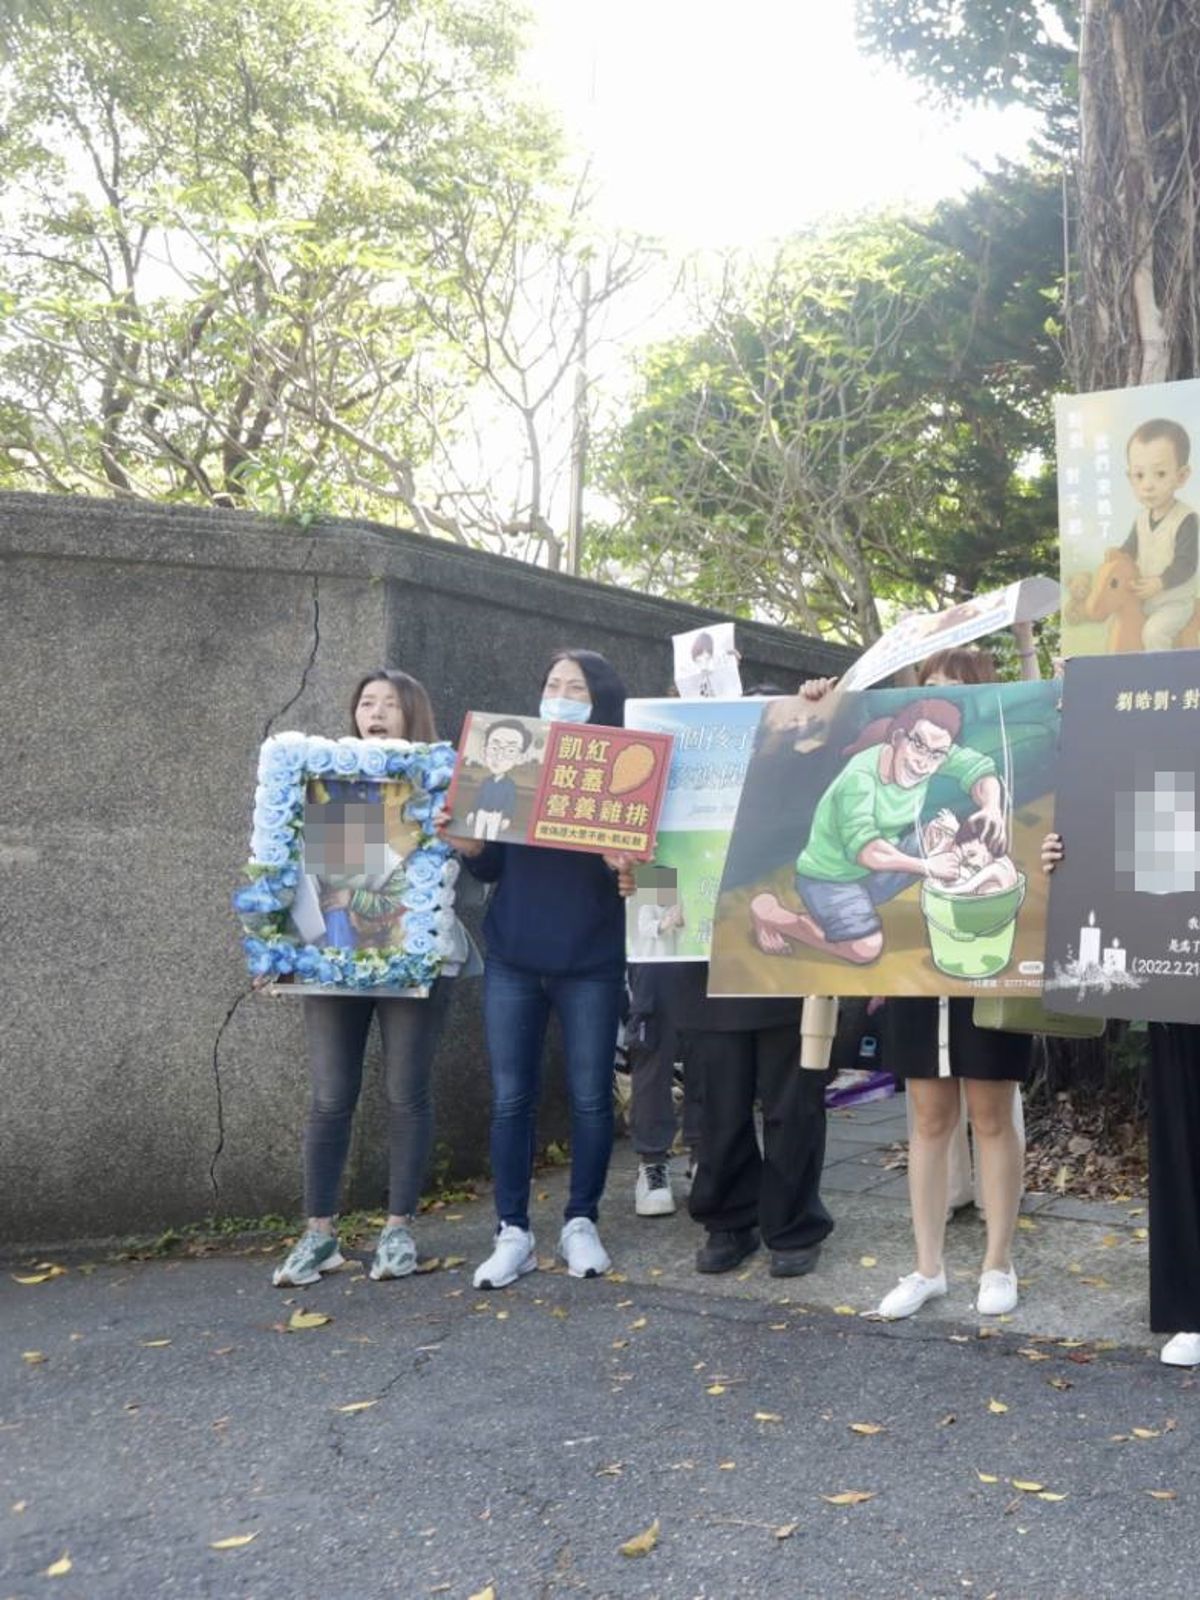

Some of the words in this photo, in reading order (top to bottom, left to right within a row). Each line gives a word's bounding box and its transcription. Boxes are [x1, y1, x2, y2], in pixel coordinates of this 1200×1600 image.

[558, 734, 611, 763] 凱紅
[552, 764, 605, 793] 敢蓋
[547, 794, 650, 827] 營養雞排
